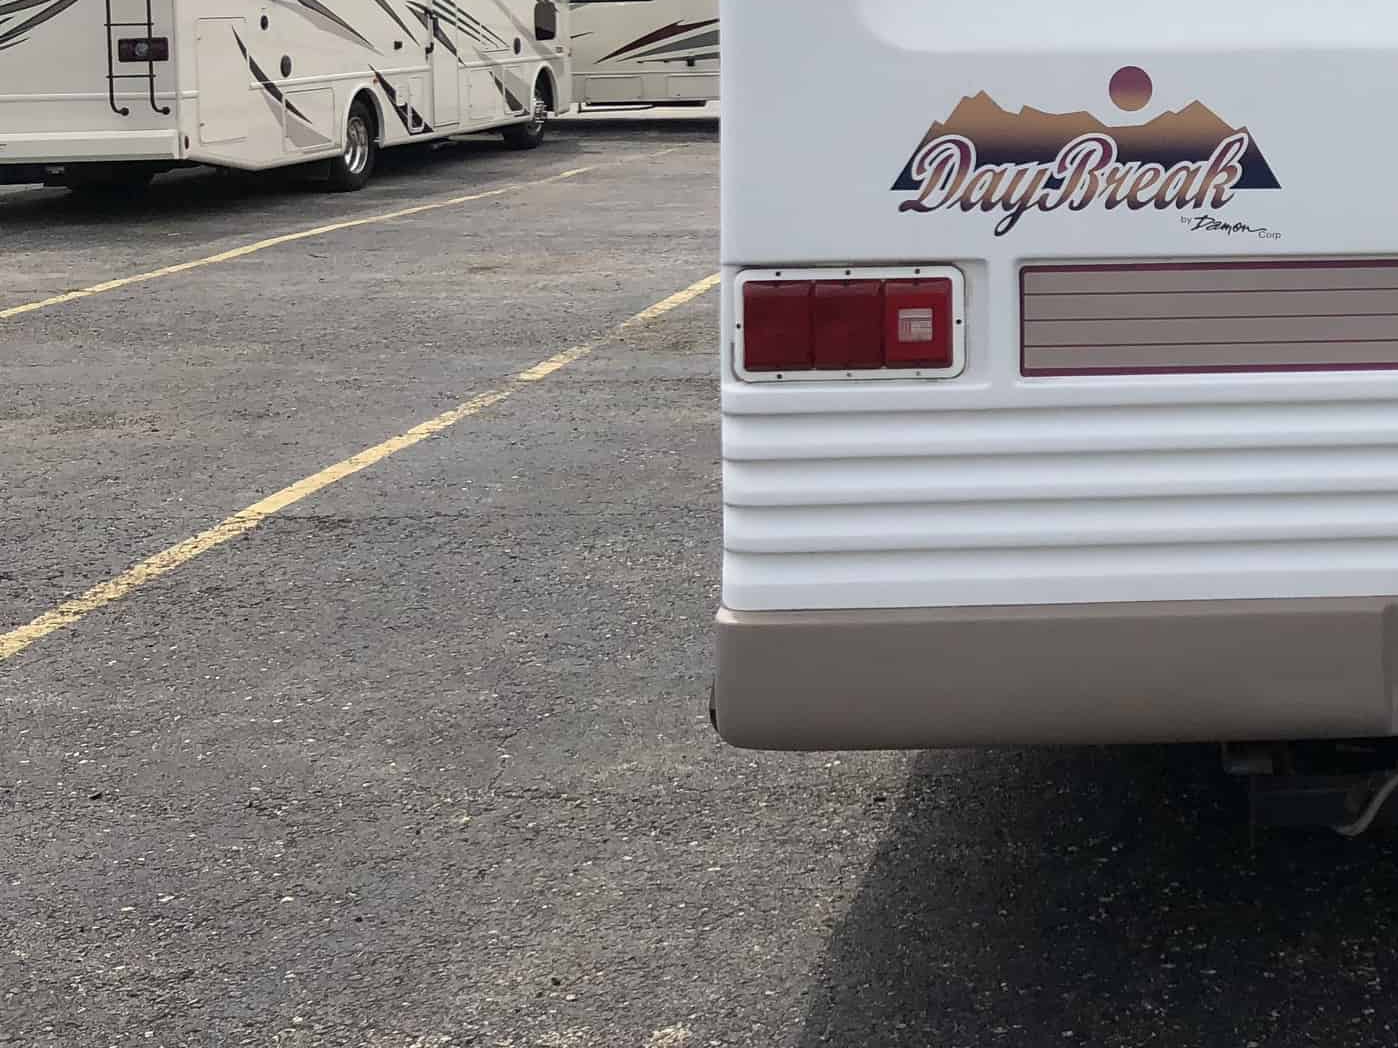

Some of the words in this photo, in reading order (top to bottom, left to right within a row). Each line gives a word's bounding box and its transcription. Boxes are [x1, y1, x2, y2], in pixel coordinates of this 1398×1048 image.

[898, 133, 1248, 237] DayBreak
[1180, 215, 1193, 225] by
[1190, 214, 1267, 237] Damon
[1257, 231, 1282, 241] Corp
